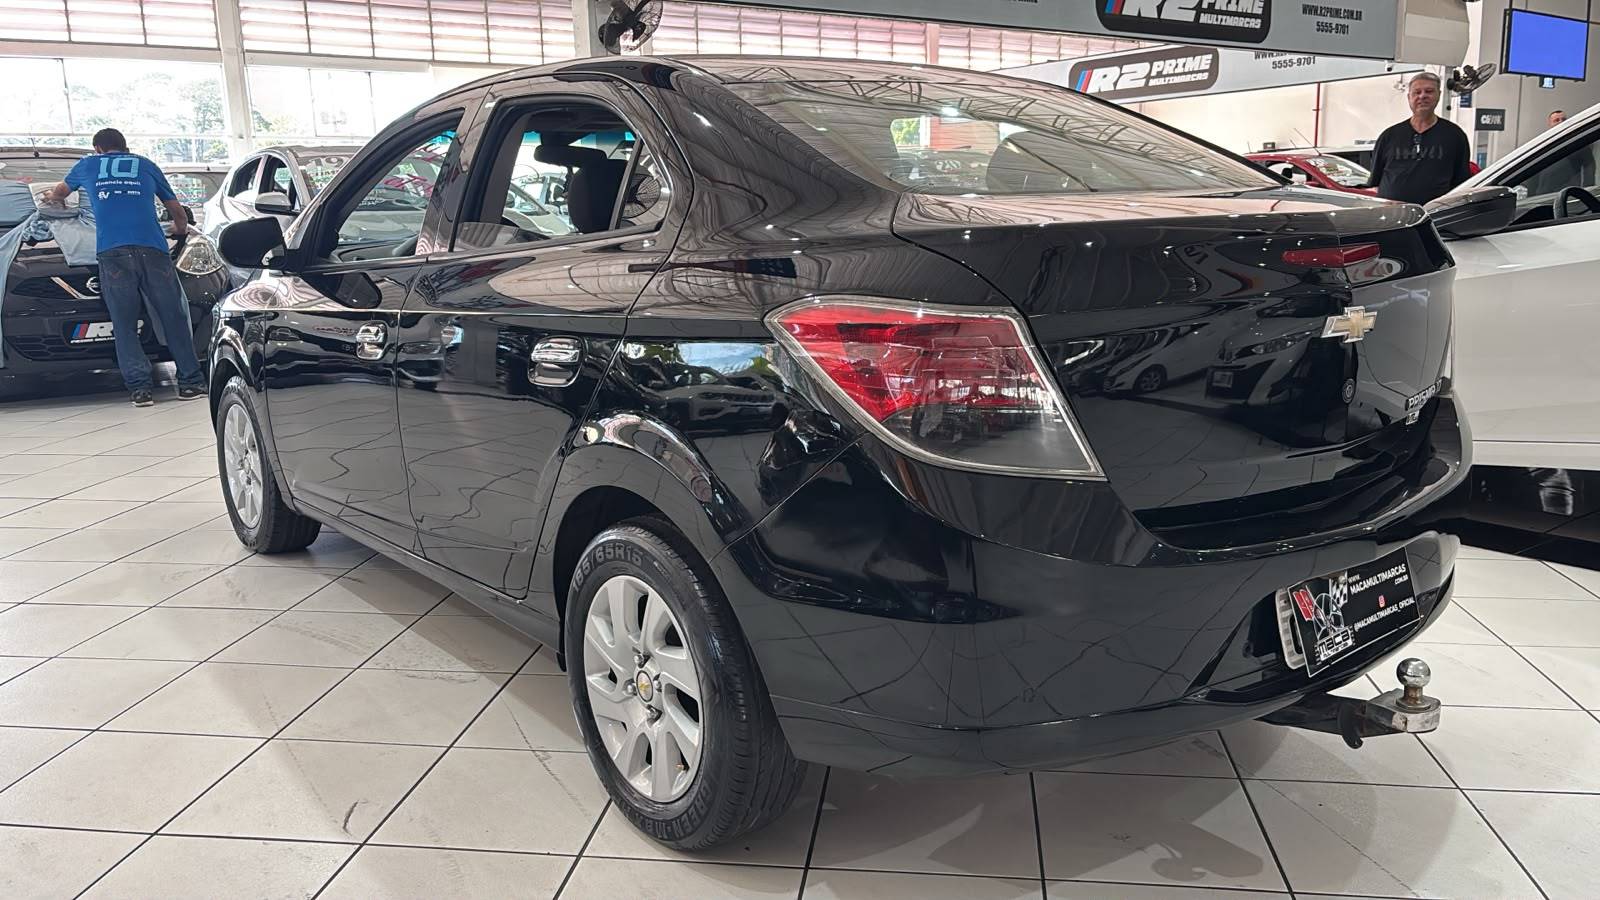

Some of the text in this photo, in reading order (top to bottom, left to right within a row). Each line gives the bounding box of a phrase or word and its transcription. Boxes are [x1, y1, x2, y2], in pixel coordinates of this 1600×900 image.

[1199, 12, 1262, 29] MULTIMARCAS
[1302, 4, 1362, 21] WWW.R2PRIME.COM.BR
[1316, 21, 1349, 35] 5555-9701
[1272, 56, 1316, 69] 5555-9701
[1086, 54, 1213, 94] R2 PRIME
[1149, 72, 1209, 86] MULTIMARCAS
[97, 157, 140, 179] 10
[1350, 563, 1406, 596] MACAMULTIMARCAS
